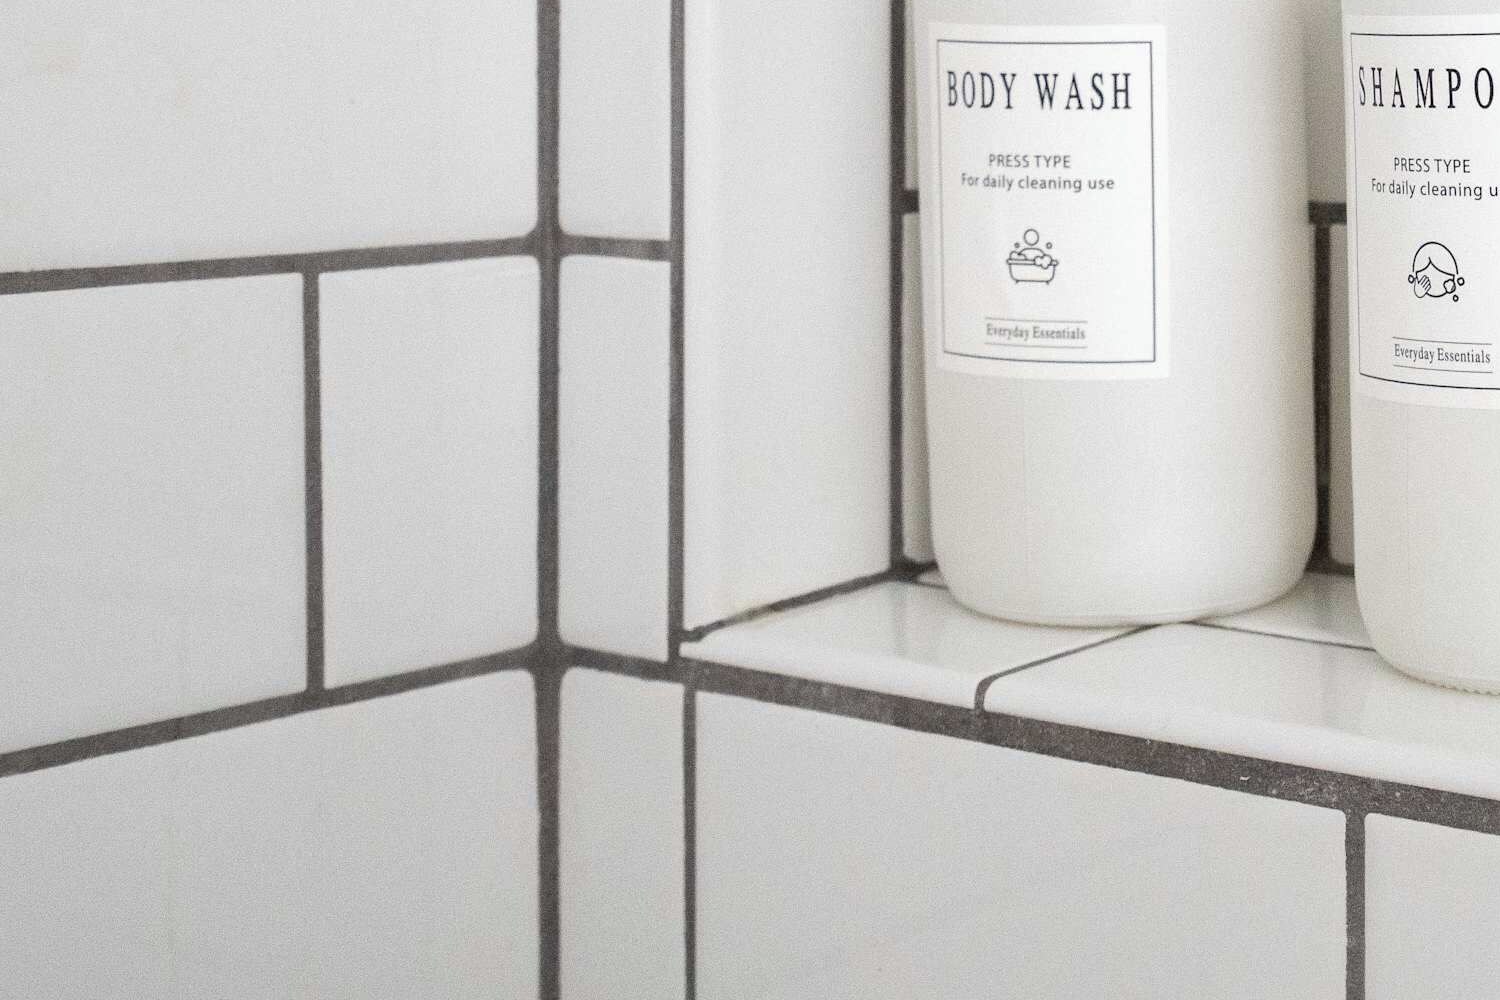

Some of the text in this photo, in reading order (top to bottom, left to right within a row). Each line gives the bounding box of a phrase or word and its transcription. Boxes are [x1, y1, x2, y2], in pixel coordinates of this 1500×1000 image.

[947, 71, 1132, 110] BODY WASH
[988, 154, 1071, 169] PRESS TYPE
[1393, 157, 1471, 174] PRESS TYPE
[961, 173, 1115, 192] For daily cleaning use
[1371, 178, 1386, 193] For
[1388, 180, 1416, 198] daily
[1420, 181, 1482, 200] cleaning
[986, 322, 1086, 341] Everyday Essentials
[1394, 343, 1491, 364] Everyday Essentials
